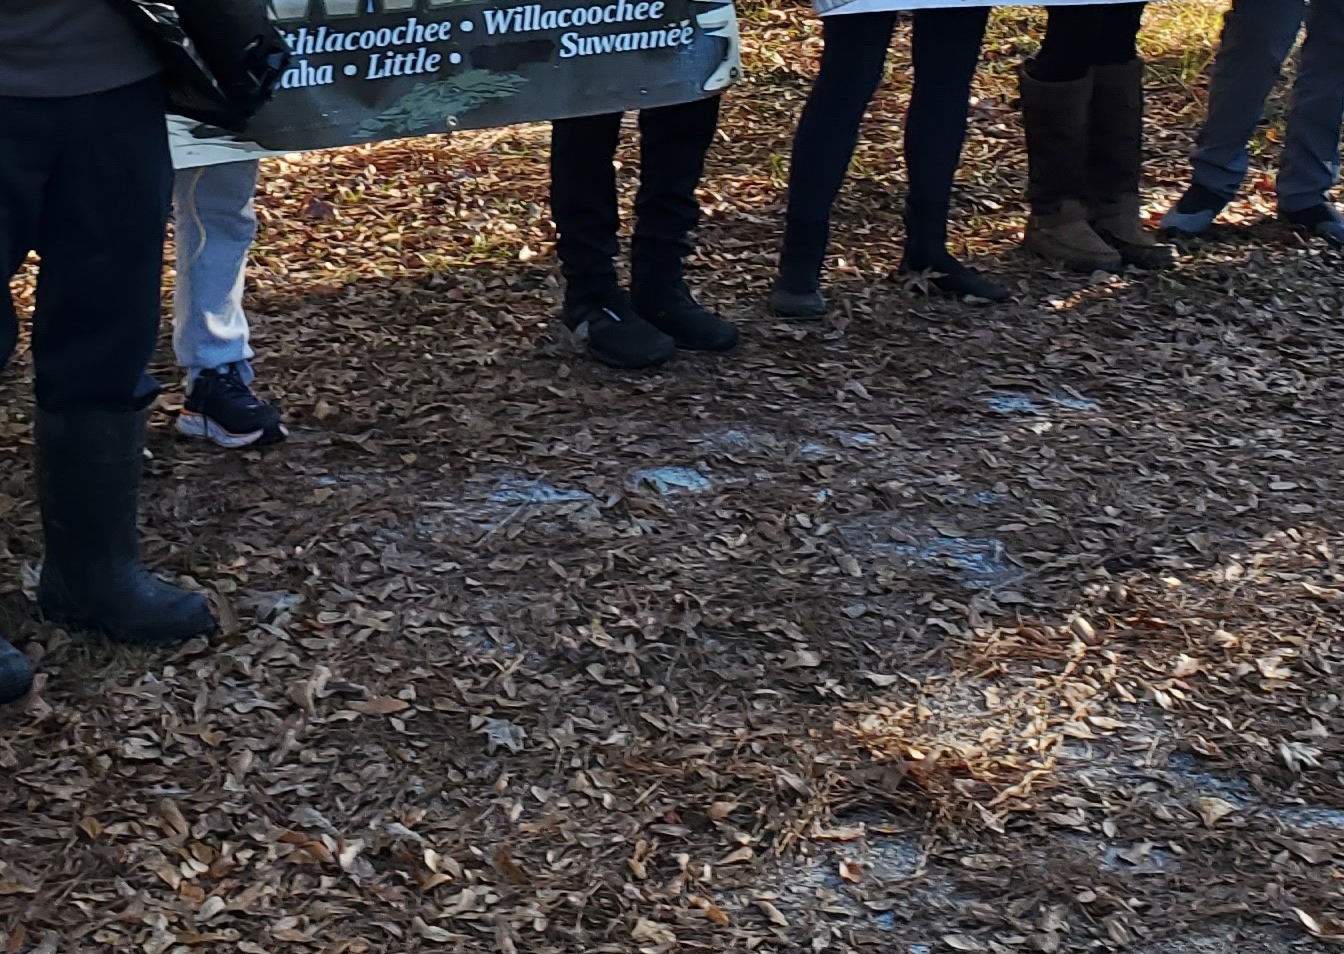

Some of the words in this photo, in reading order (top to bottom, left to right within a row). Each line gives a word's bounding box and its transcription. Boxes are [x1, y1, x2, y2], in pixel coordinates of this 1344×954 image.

[278, 17, 452, 56] thlacoochee
[365, 47, 442, 80] Little
[559, 27, 694, 58] Suwannee
